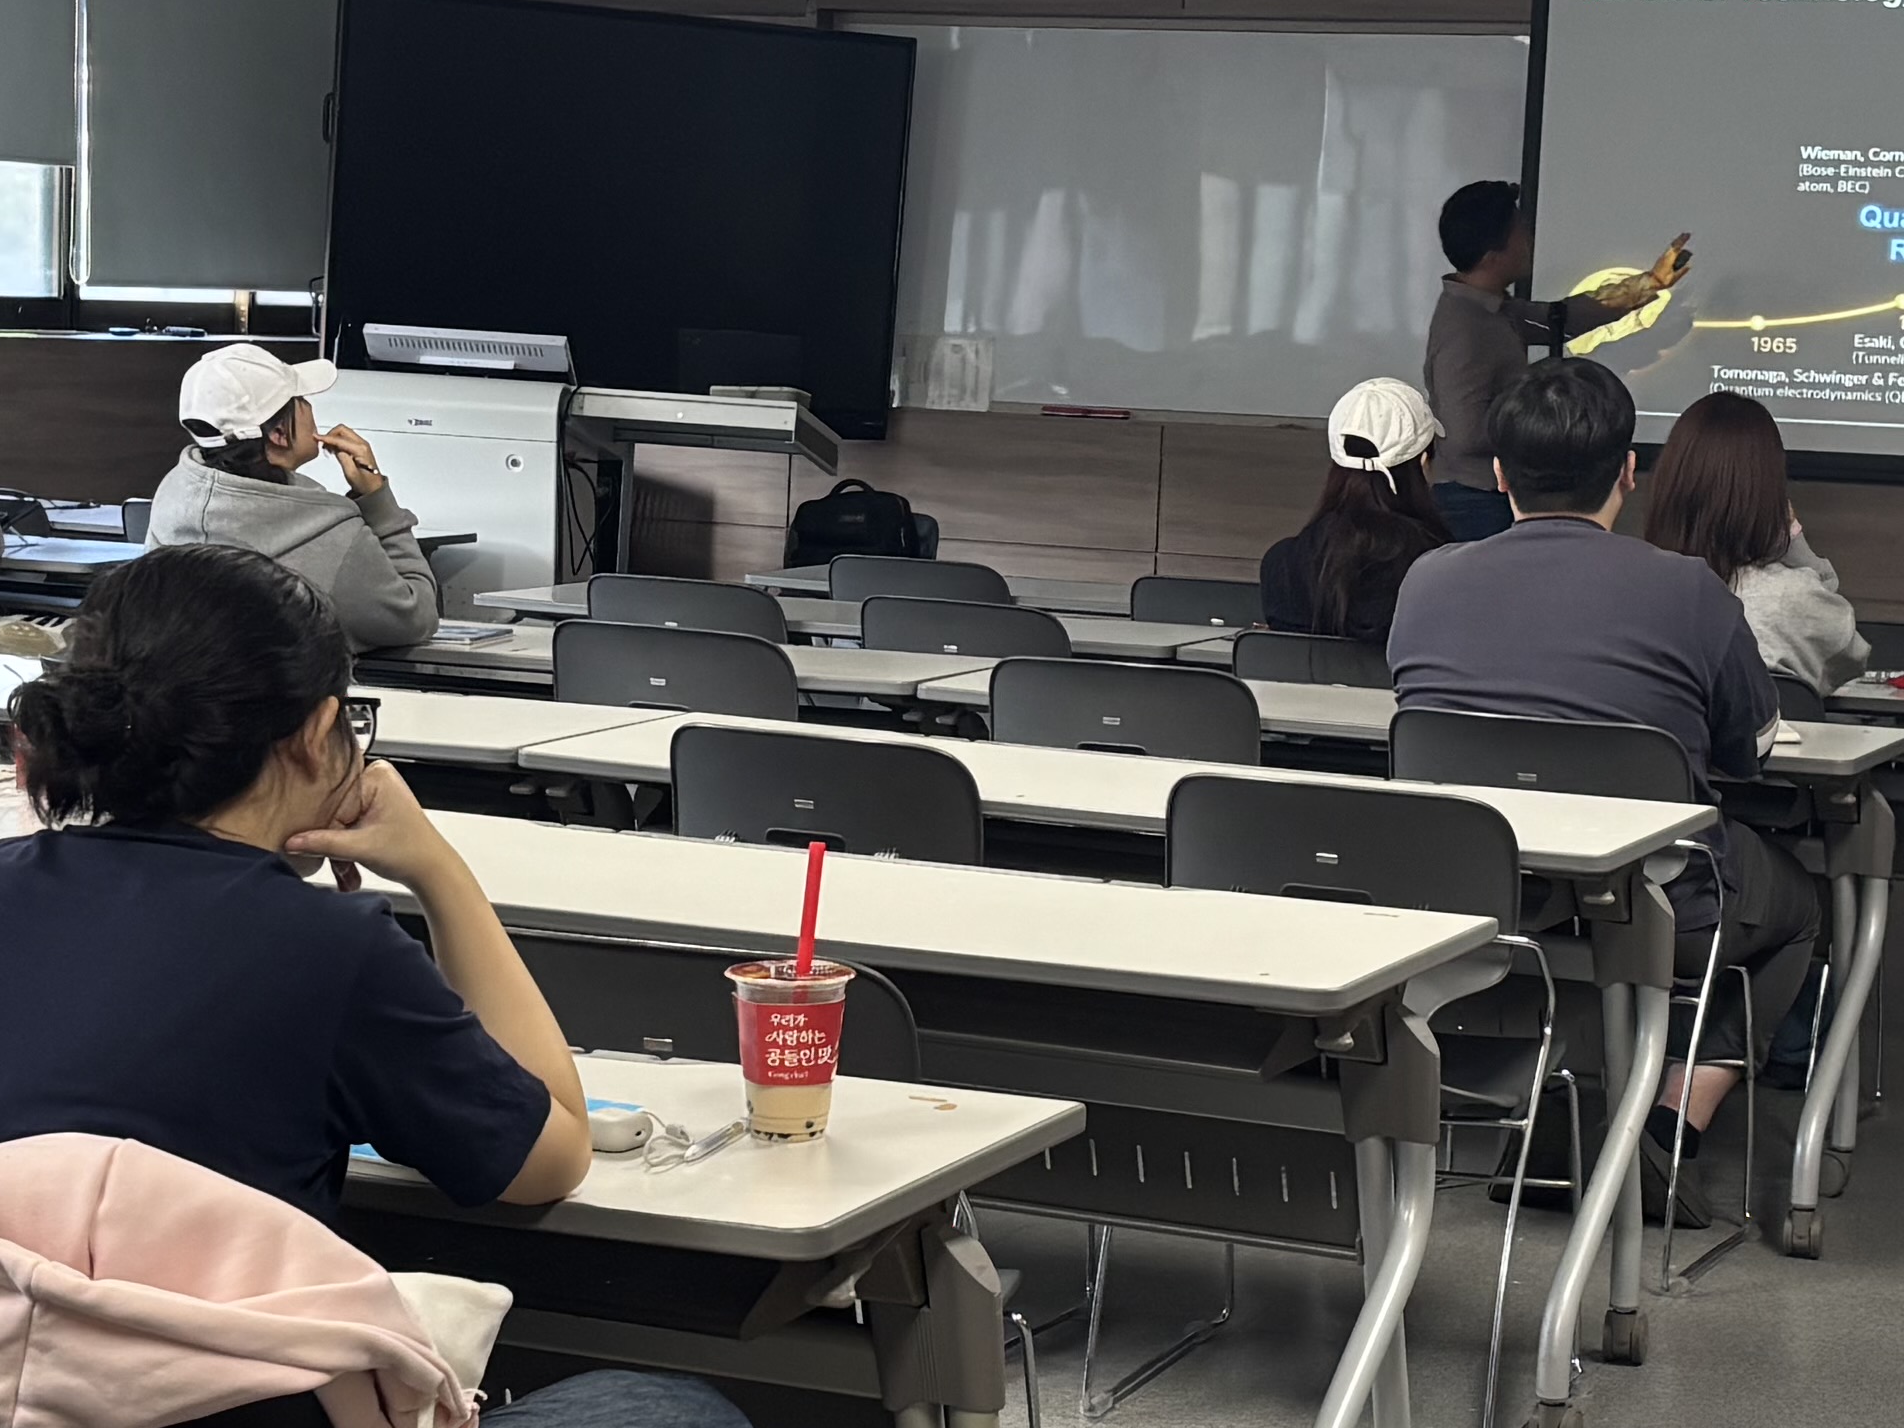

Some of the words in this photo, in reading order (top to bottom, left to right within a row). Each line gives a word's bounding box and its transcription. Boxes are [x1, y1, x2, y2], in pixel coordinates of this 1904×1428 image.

[1799, 164, 1892, 179] (Bose-Einstein
[1796, 181, 1835, 194] atom,
[1837, 181, 1871, 194] BEC)
[1751, 336, 1797, 353] 1965
[1854, 334, 1895, 351] Esaki,
[1711, 364, 1789, 383] Tomonaga,
[1793, 368, 1869, 387] Schwinger
[1872, 372, 1884, 386] &
[1776, 387, 1882, 402] electrodynamics
[770, 1013, 808, 1028] 우리가
[765, 1029, 826, 1046] 사랑하는
